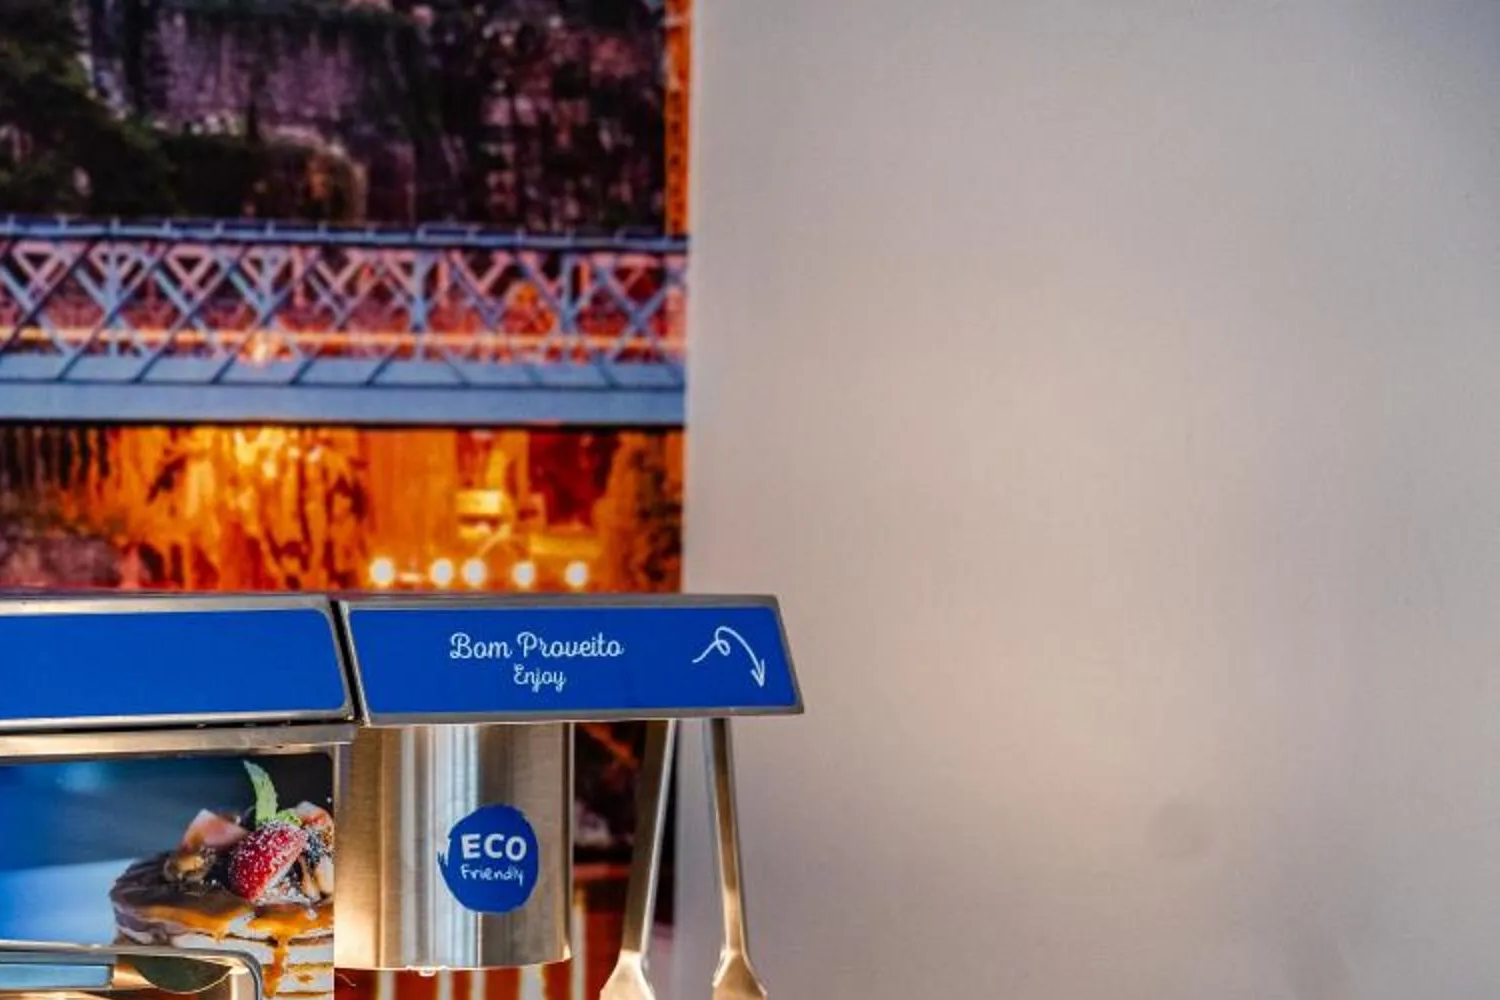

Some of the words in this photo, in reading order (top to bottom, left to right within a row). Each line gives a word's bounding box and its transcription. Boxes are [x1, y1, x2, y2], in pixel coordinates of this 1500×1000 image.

[449, 632, 512, 660] Bom
[516, 631, 624, 658] Proveito
[513, 664, 567, 692] Enjoy
[460, 833, 527, 860] ECO
[460, 864, 524, 886] Friendly
